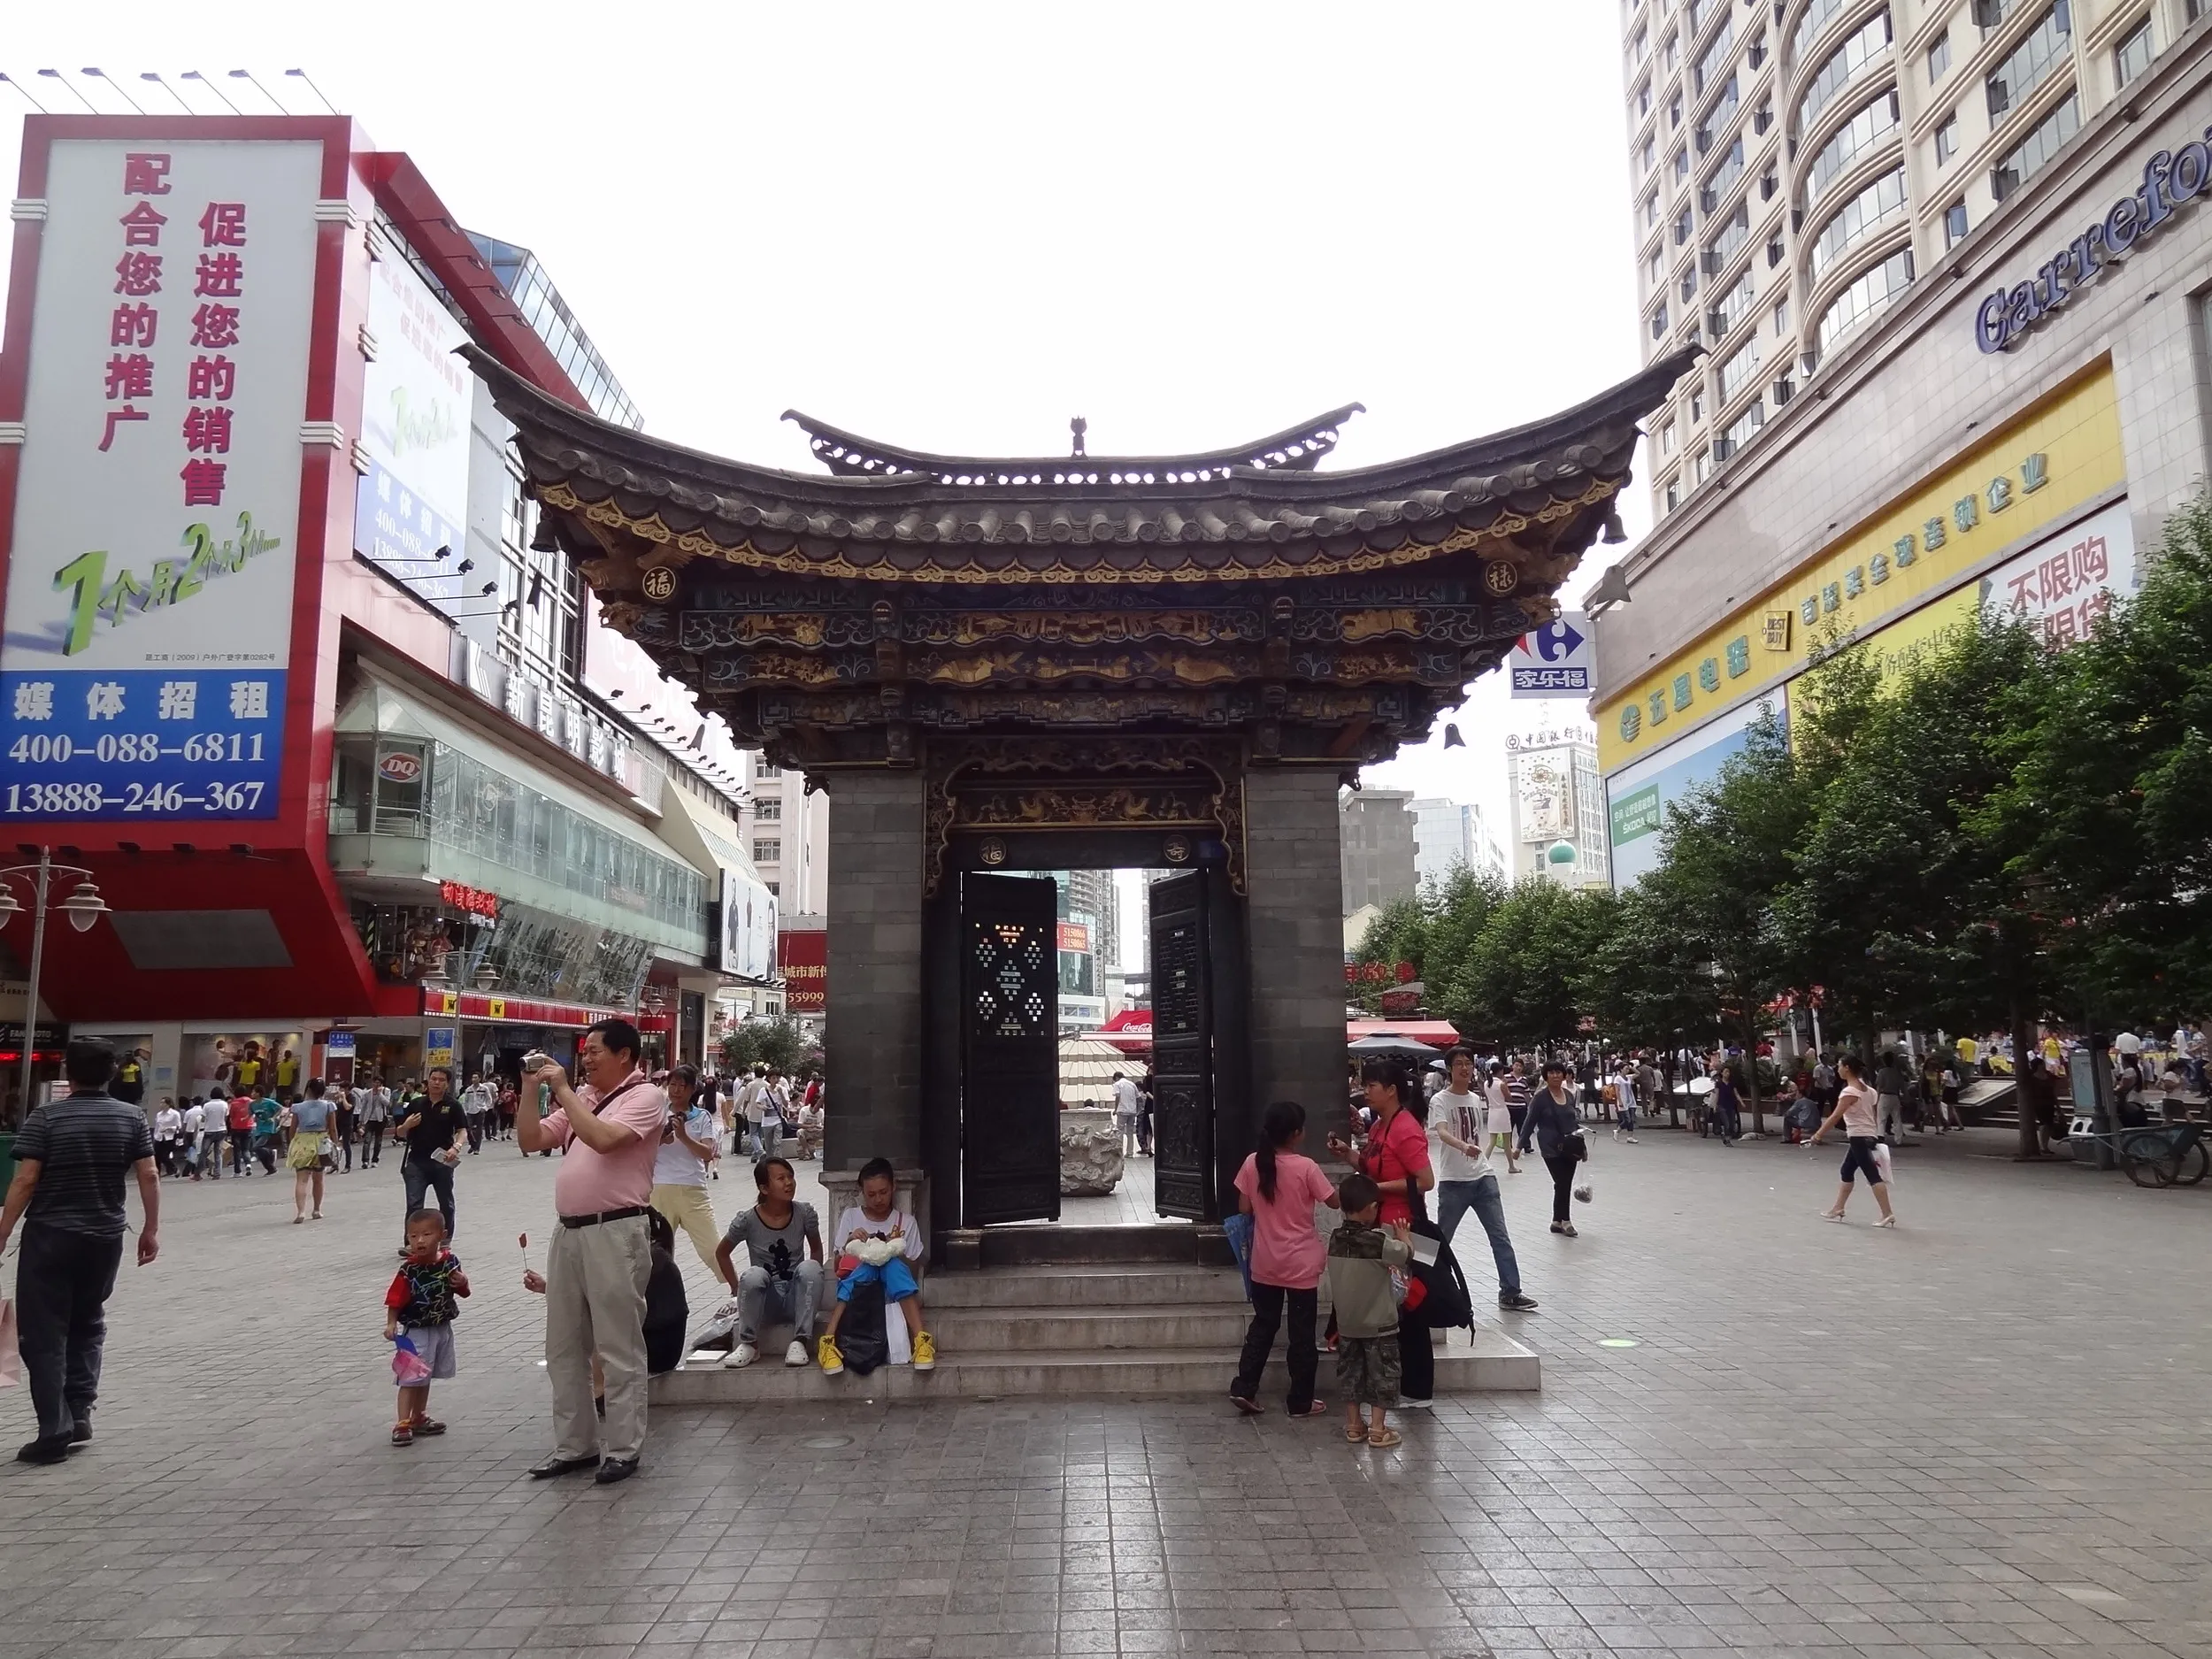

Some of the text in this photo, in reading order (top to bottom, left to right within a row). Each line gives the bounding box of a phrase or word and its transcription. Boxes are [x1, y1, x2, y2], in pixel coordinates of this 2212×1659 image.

[1975, 124, 2212, 354] Carrefo
[98, 152, 173, 452] 配合您的推广
[180, 202, 247, 507] 促进您的销售
[647, 570, 672, 596] 福
[2007, 535, 2108, 616] 不限购
[1767, 618, 1786, 630] BEST
[1767, 632, 1785, 644] BUY
[1515, 670, 1586, 687] 家乐福
[1648, 634, 1752, 727] 五星电器
[14, 681, 269, 720] 媒体招租
[504, 670, 626, 784] 新昆明影城
[9, 732, 265, 763] 400-088-6811
[386, 758, 417, 777] DQ
[4, 782, 265, 812] 13888-246-367
[1122, 1022, 1153, 1033] Coca-Col
